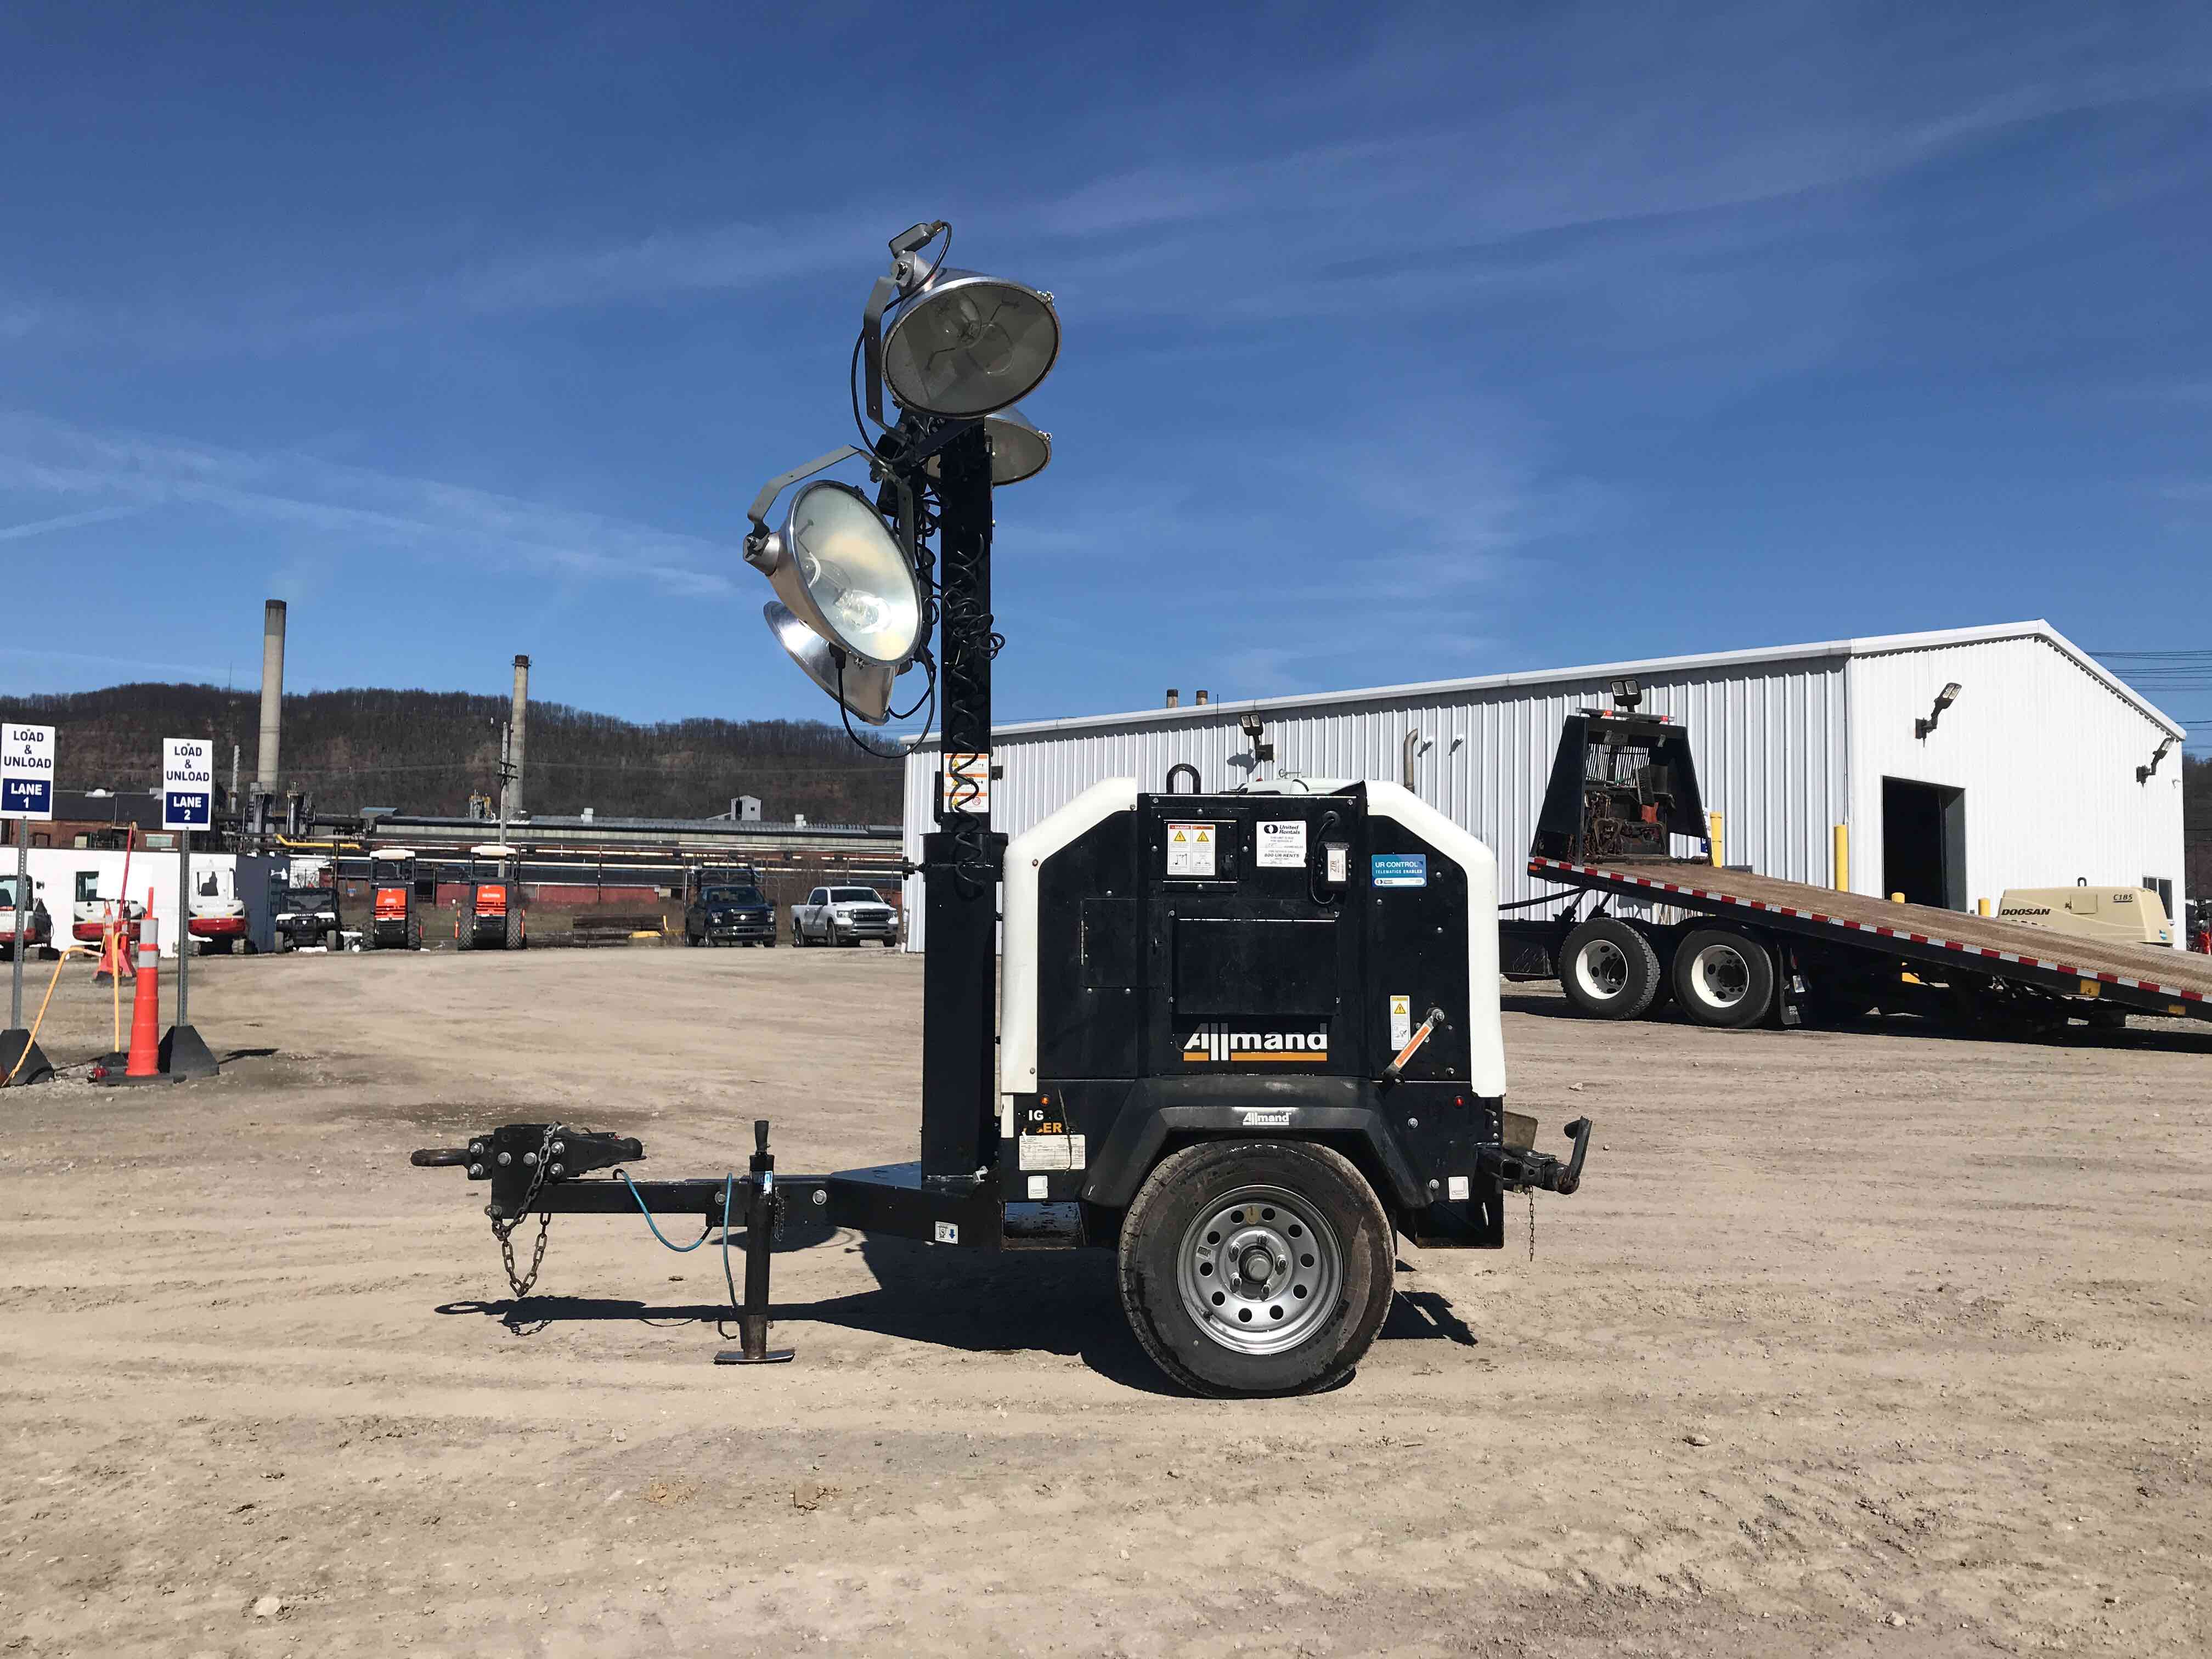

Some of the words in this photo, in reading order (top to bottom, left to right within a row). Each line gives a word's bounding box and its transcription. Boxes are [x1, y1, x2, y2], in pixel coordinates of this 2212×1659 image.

[13, 730, 44, 742] LOAD
[24, 744, 32, 754] &
[174, 746, 202, 757] LOAD
[4, 756, 52, 768] UNLOAD
[184, 759, 192, 769] &
[166, 771, 210, 781] UNLOAD
[11, 783, 42, 795] LANE
[23, 797, 29, 808] 1
[173, 797, 201, 808] LANE
[184, 810, 190, 820] 2
[1183, 1023, 1327, 1060] Allmand
[1243, 1112, 1289, 1125] Allmand
